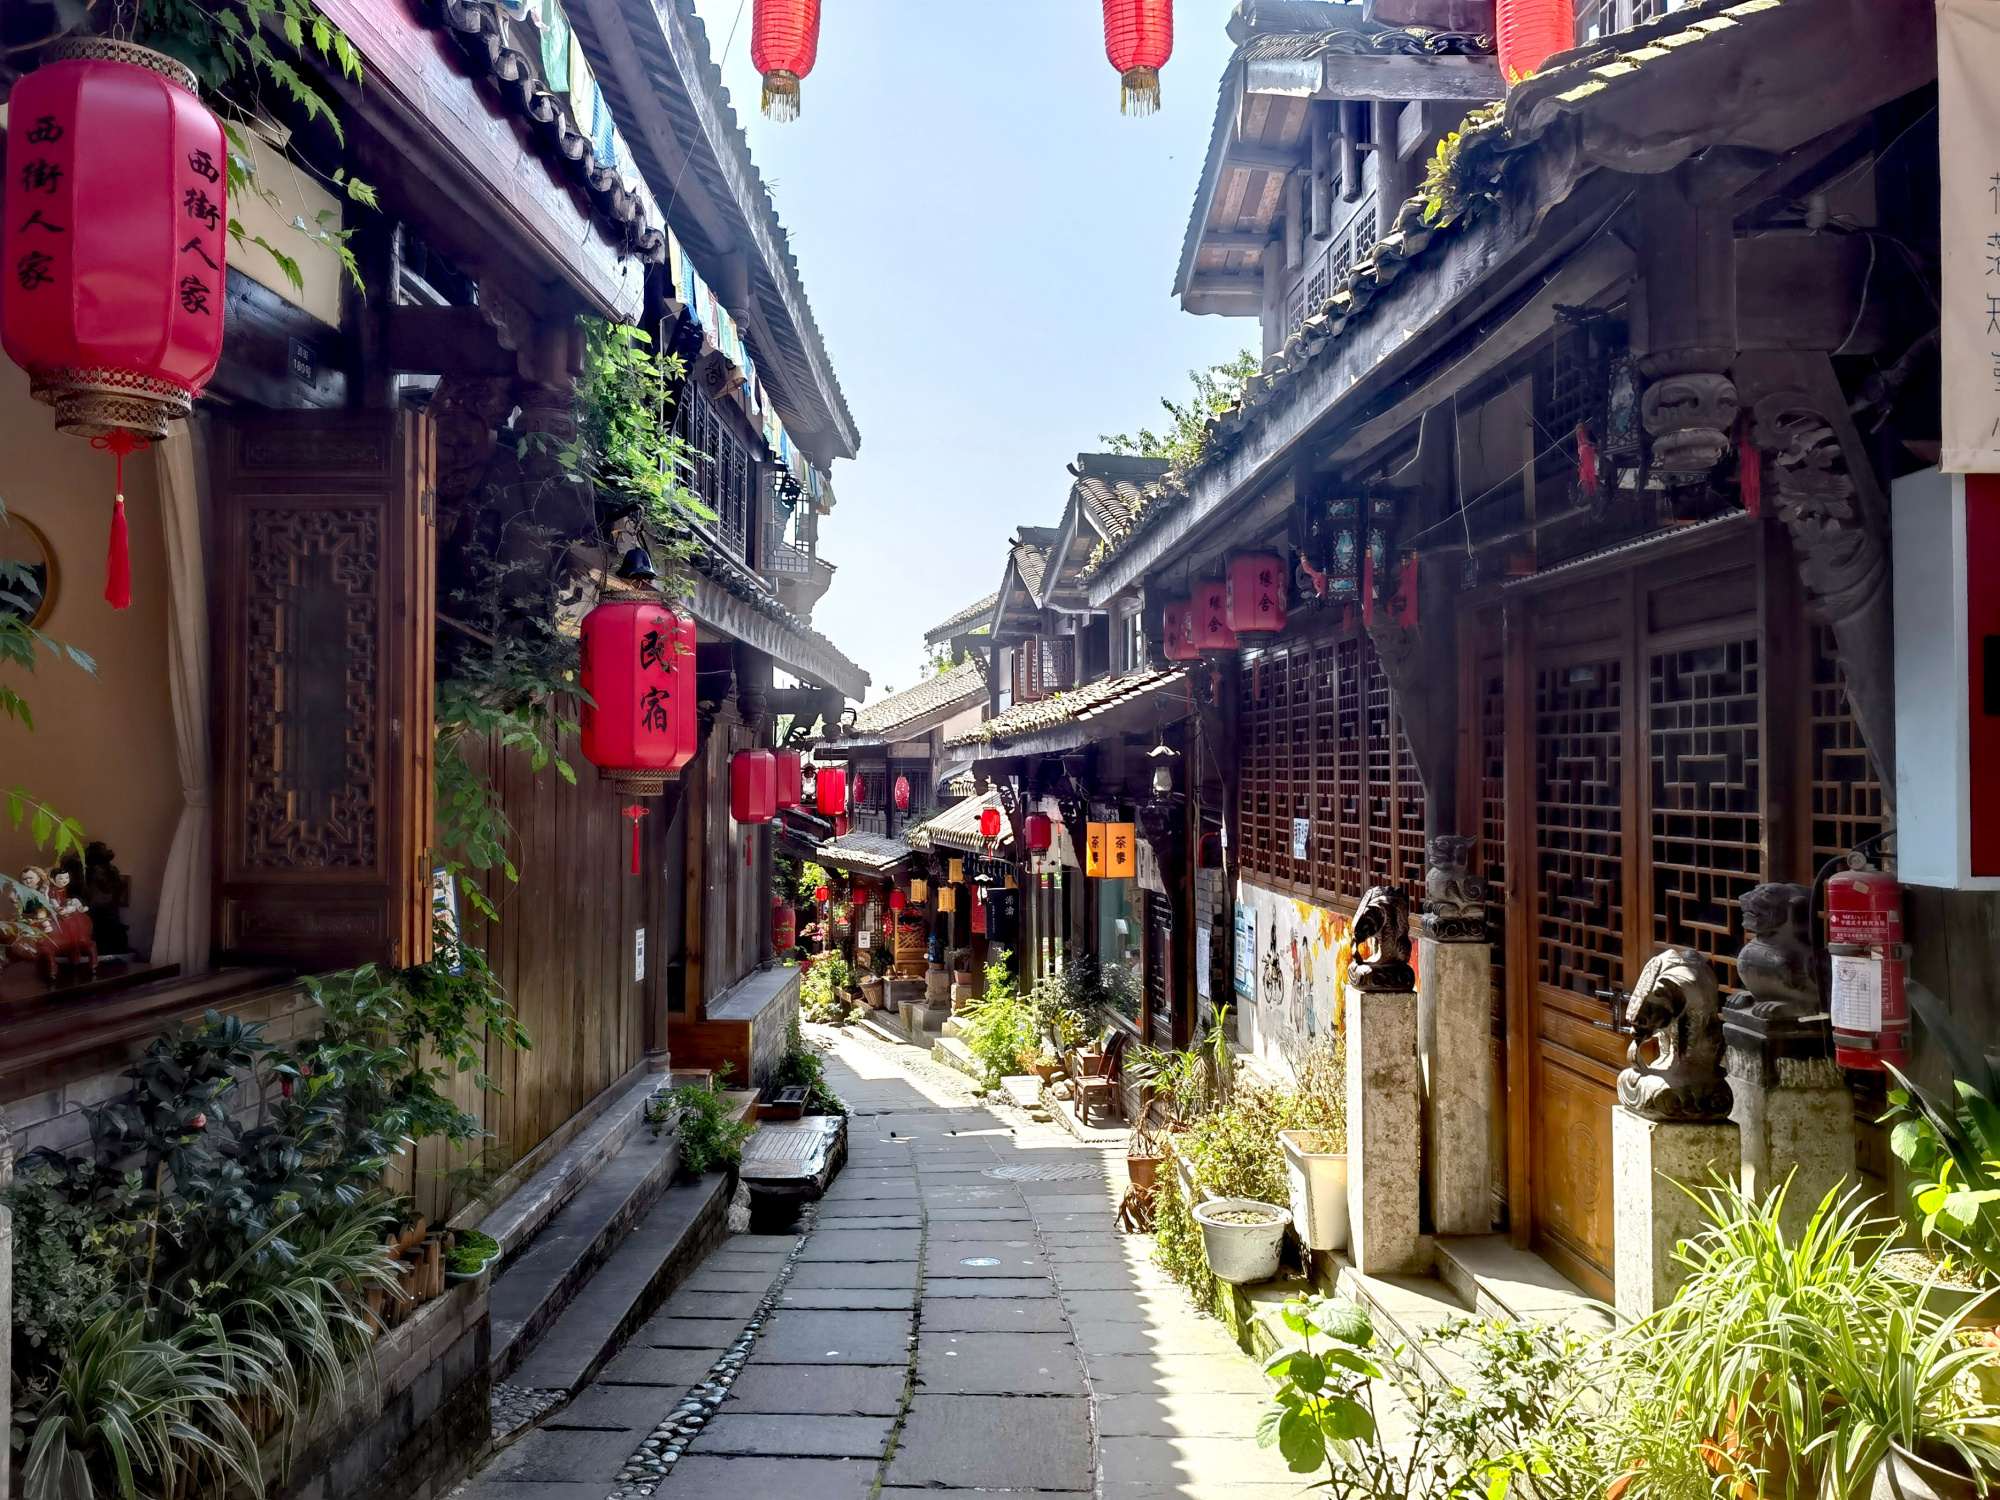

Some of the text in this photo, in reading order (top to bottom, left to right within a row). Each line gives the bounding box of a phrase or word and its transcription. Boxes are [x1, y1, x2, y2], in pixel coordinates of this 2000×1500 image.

[18, 115, 65, 290] 西街人家
[180, 148, 221, 316] 西街人家
[640, 630, 671, 733] 民宿
